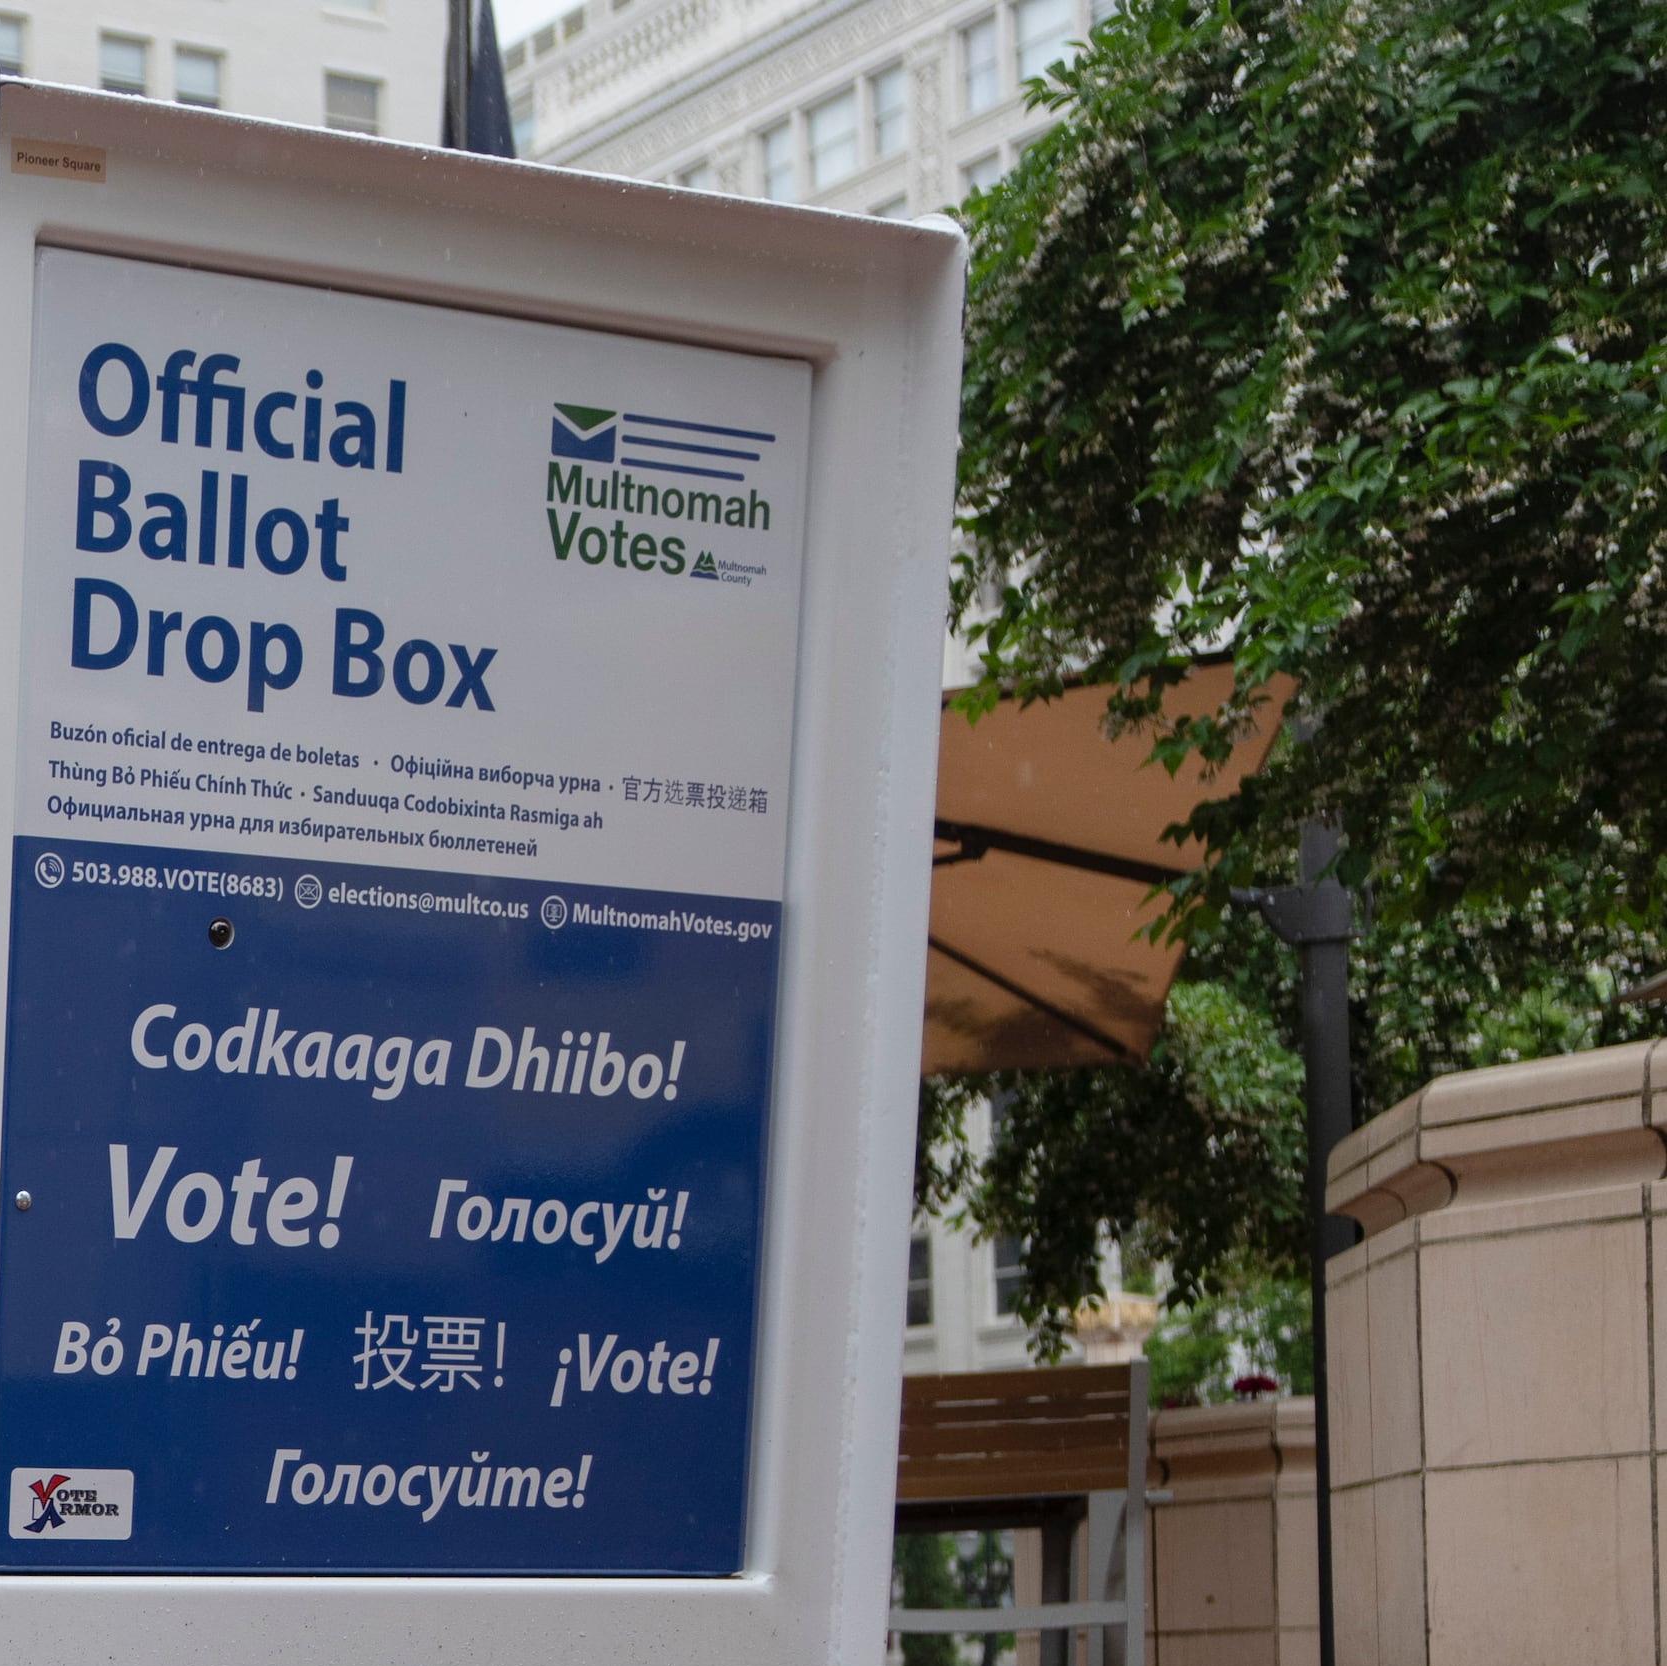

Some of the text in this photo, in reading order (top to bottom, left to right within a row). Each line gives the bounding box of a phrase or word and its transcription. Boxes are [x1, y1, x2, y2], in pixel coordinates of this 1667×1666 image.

[17, 152, 101, 173] Pioneer Square
[78, 342, 406, 474] Official
[75, 459, 350, 582] Ballot
[547, 461, 771, 530] Multnomah
[547, 508, 686, 575] Votes
[718, 559, 767, 576] Multnomah
[721, 571, 752, 587] County
[71, 577, 498, 713] Drop Box
[50, 721, 359, 769] Buzón oficial de entrega de boletas
[49, 759, 293, 800] Thùng Bỏ Phiếu Chính Thức
[390, 753, 601, 795] Офіційна виборча урна
[47, 794, 538, 857] Официальная урна для избирательных бюллетеней
[313, 785, 603, 830] Sanduuqa Codobixinta Rasmiga ah
[71, 861, 284, 901] 503.988.VOTE(8683)
[328, 882, 529, 920] elections@multco.us
[573, 903, 772, 942] MultnomahVotes.gov
[130, 1003, 686, 1101] Codkaaga Dhiibo!
[109, 1143, 354, 1249] Vote!
[429, 1178, 689, 1264] Голосуй!
[52, 1317, 305, 1380] Bỏ Phiếu!
[550, 1333, 721, 1408] ¡Vote!
[28, 1474, 97, 1510] VOTE
[266, 1448, 593, 1523] Голосуйте!
[23, 1498, 119, 1533] ARMOR
